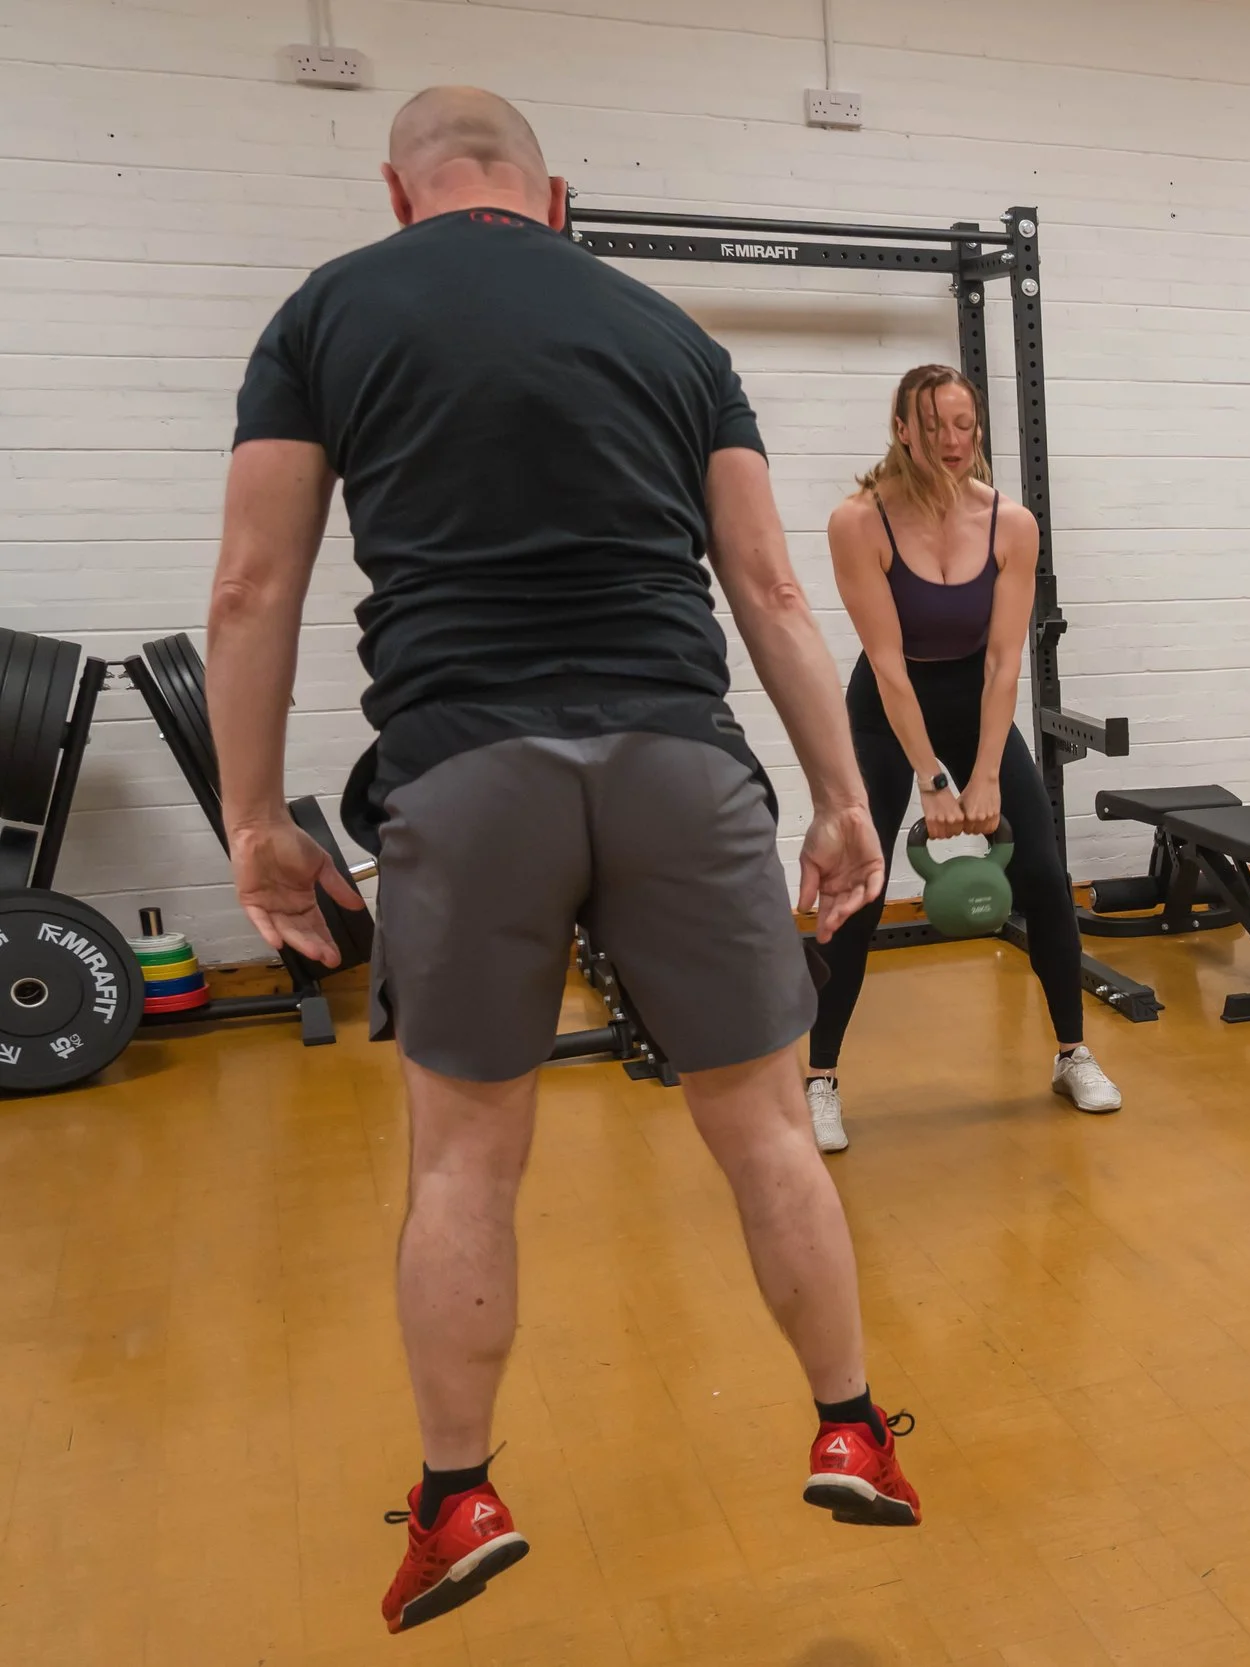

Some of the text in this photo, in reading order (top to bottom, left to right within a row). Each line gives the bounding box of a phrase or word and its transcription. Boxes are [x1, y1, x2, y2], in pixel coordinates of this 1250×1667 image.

[735, 244, 799, 260] MIRAFIT
[59, 930, 118, 1021] MIRAFIT
[50, 1036, 76, 1059] 15
[69, 1033, 85, 1049] KG
